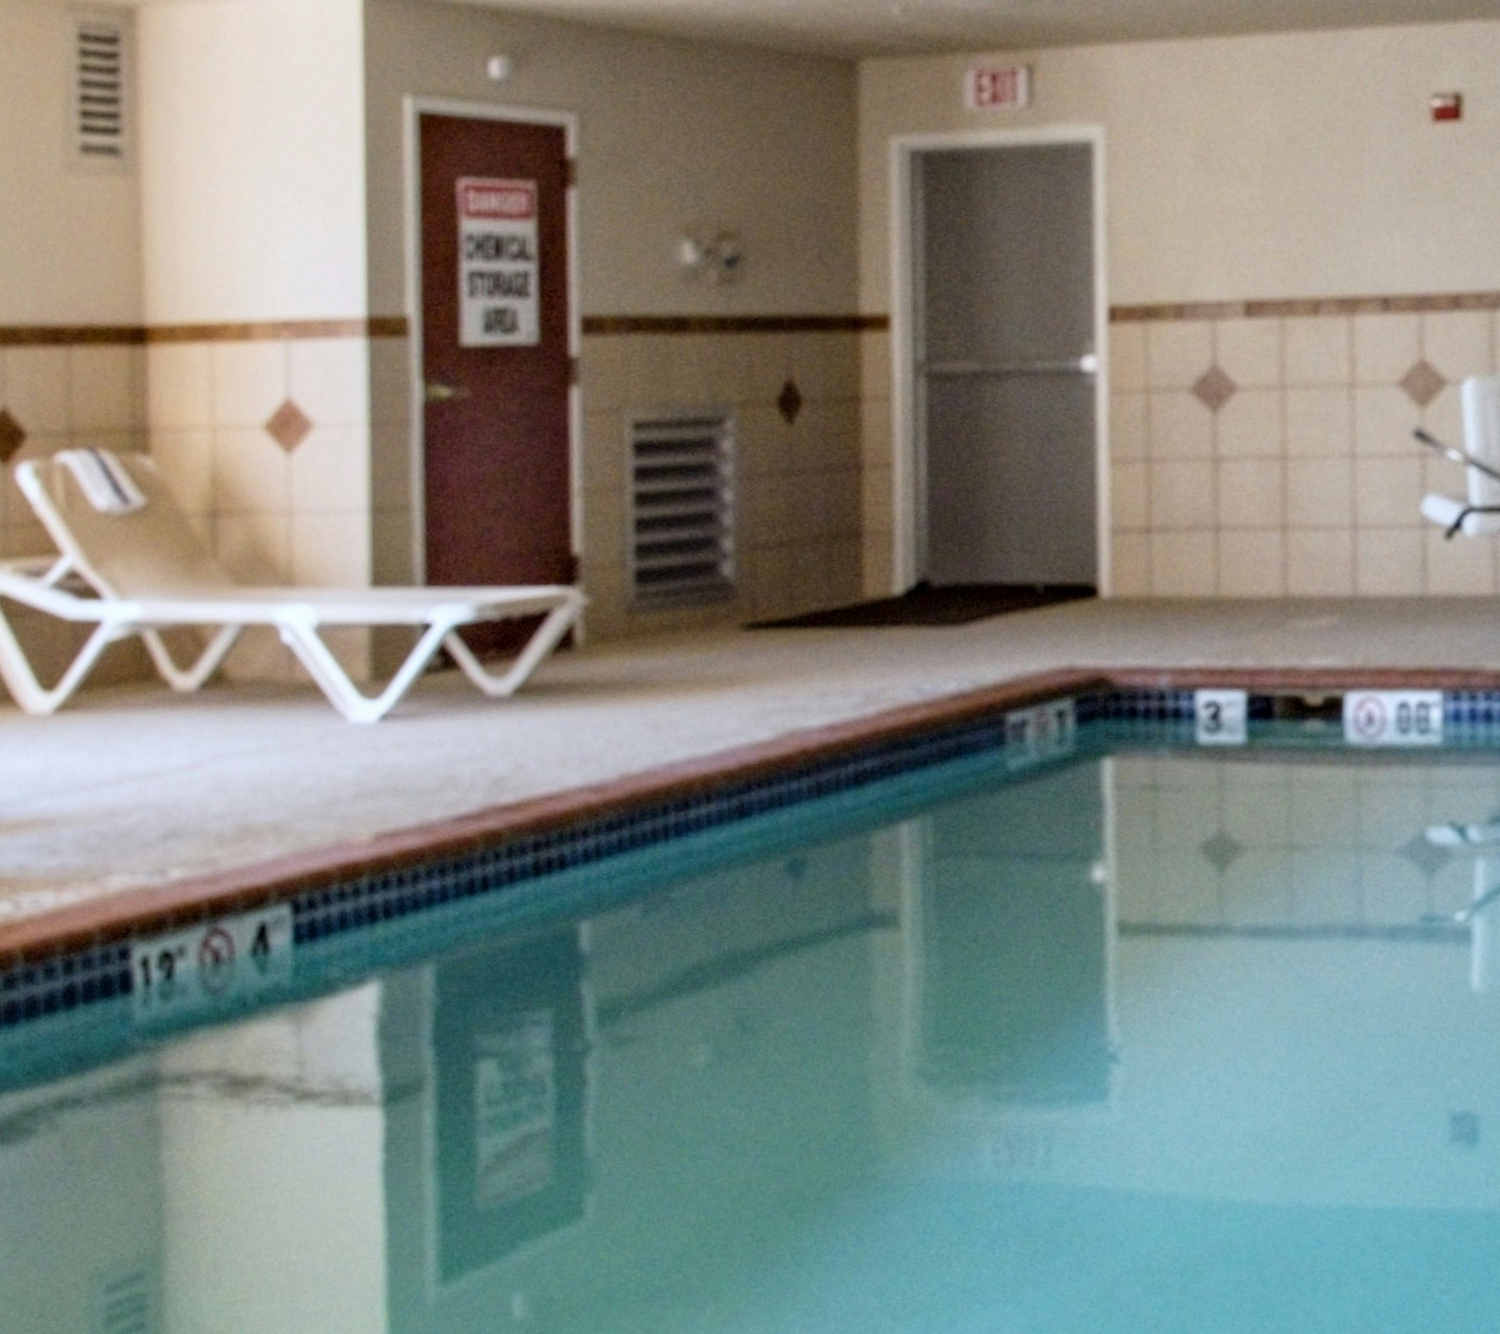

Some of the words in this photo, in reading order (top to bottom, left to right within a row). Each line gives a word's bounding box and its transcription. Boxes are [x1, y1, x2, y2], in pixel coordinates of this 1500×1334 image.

[465, 233, 532, 261] CHEMICAL
[468, 270, 530, 298] STORAGE
[483, 307, 518, 334] AREA
